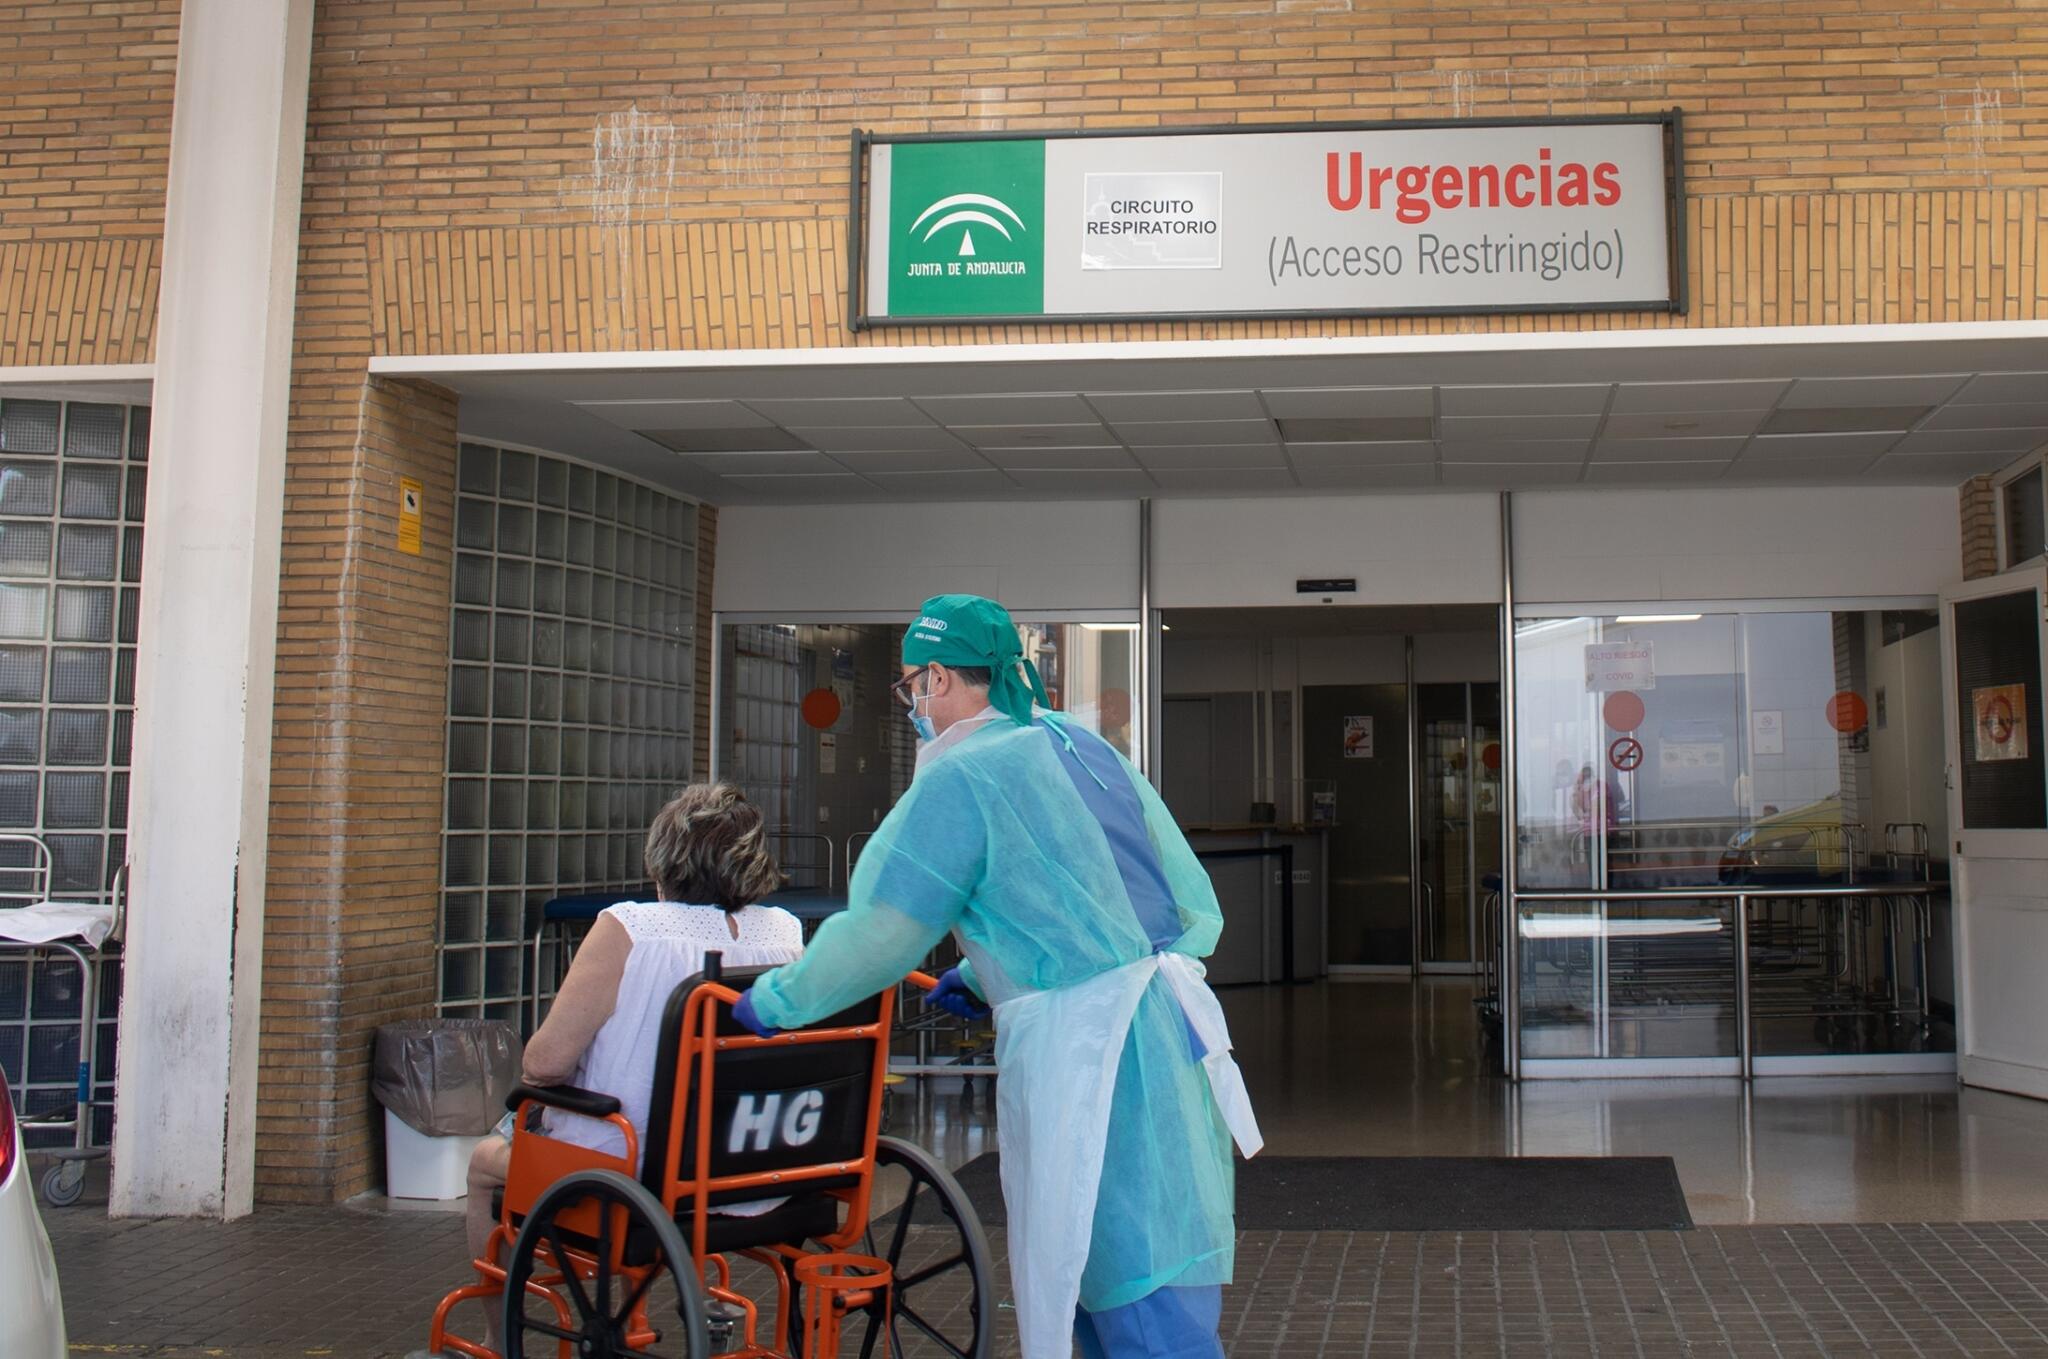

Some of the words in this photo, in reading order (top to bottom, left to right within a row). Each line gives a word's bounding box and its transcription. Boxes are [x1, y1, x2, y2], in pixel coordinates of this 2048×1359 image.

[1326, 147, 1622, 225] Urgencias
[1110, 199, 1194, 215] CIRCUITO
[1086, 219, 1218, 236] RESPIRATORIO
[1268, 235, 1403, 287] (Acceso
[1418, 228, 1624, 281] Restringido)
[907, 262, 943, 277] JUNTA
[947, 262, 962, 276] DE
[1606, 671, 1634, 681] COVID
[727, 1089, 825, 1154] HG
